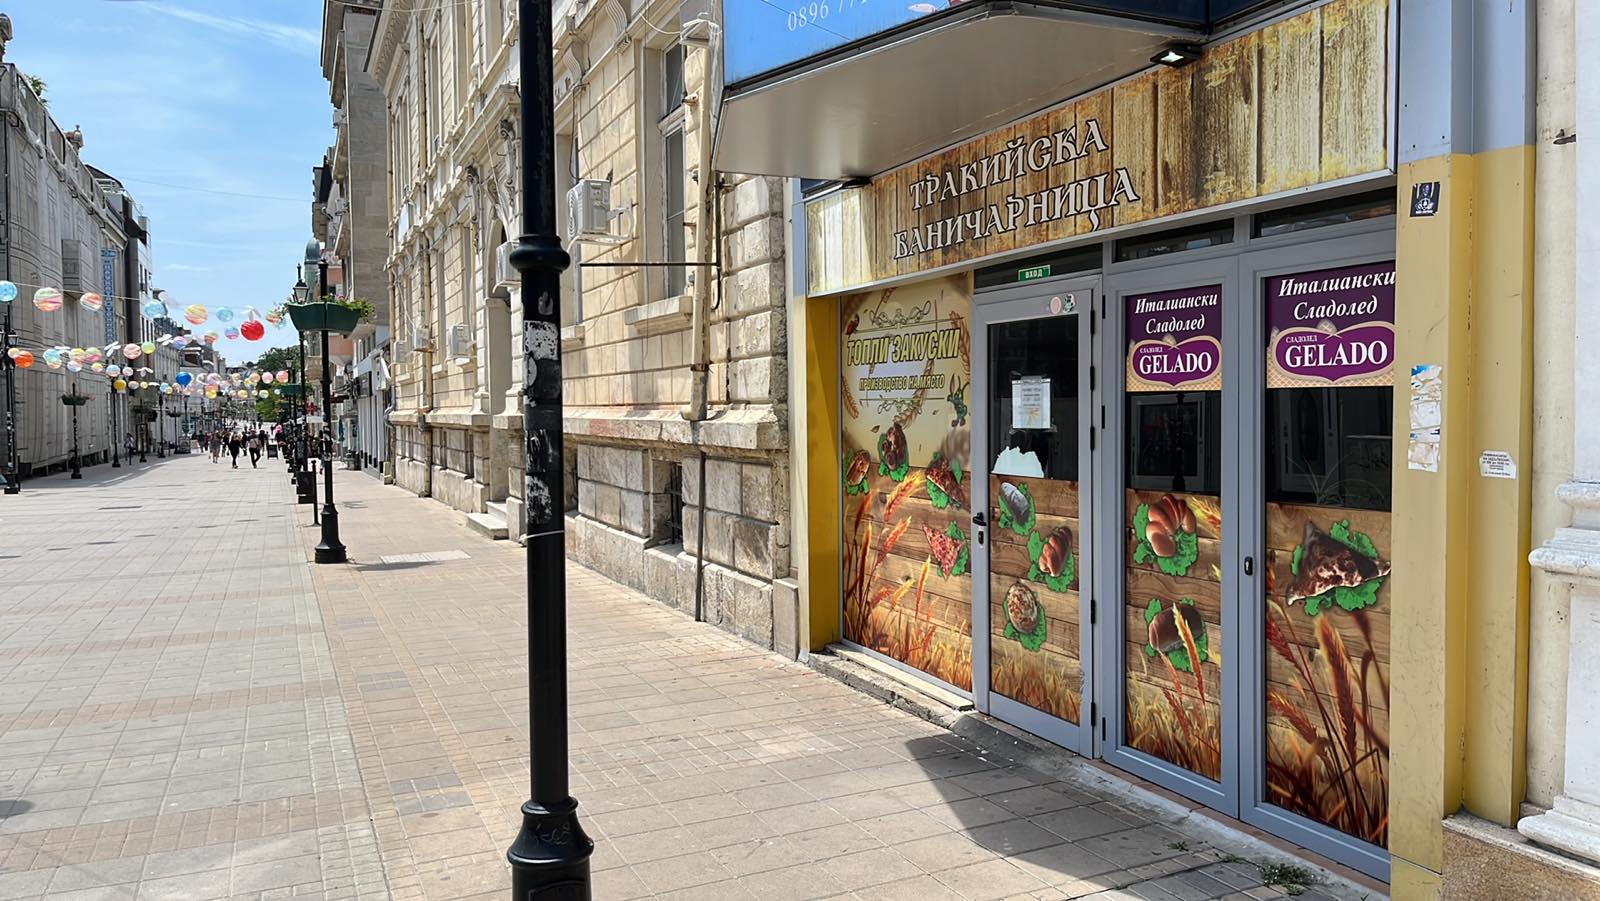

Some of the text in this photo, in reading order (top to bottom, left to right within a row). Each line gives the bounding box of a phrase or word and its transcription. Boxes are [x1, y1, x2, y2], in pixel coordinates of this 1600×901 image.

[788, 0, 829, 31] 0896
[909, 119, 1109, 210] ТРАКИЙСКА
[894, 168, 1140, 260] БАНИЧАРНИЦА
[1025, 269, 1043, 279] ВХОД
[1278, 271, 1396, 297] Италиански
[1135, 294, 1218, 314] Италиански
[1294, 295, 1378, 320] Сладолед
[1146, 314, 1205, 334] Сладолед
[847, 328, 962, 366] ТОПЛИ ЗАКУСКИ
[1285, 340, 1388, 368] GELADO
[1139, 352, 1212, 375] GELADO
[859, 375, 907, 392] ПРОИЗВОДСТВО
[919, 374, 945, 390] МЯСТО
